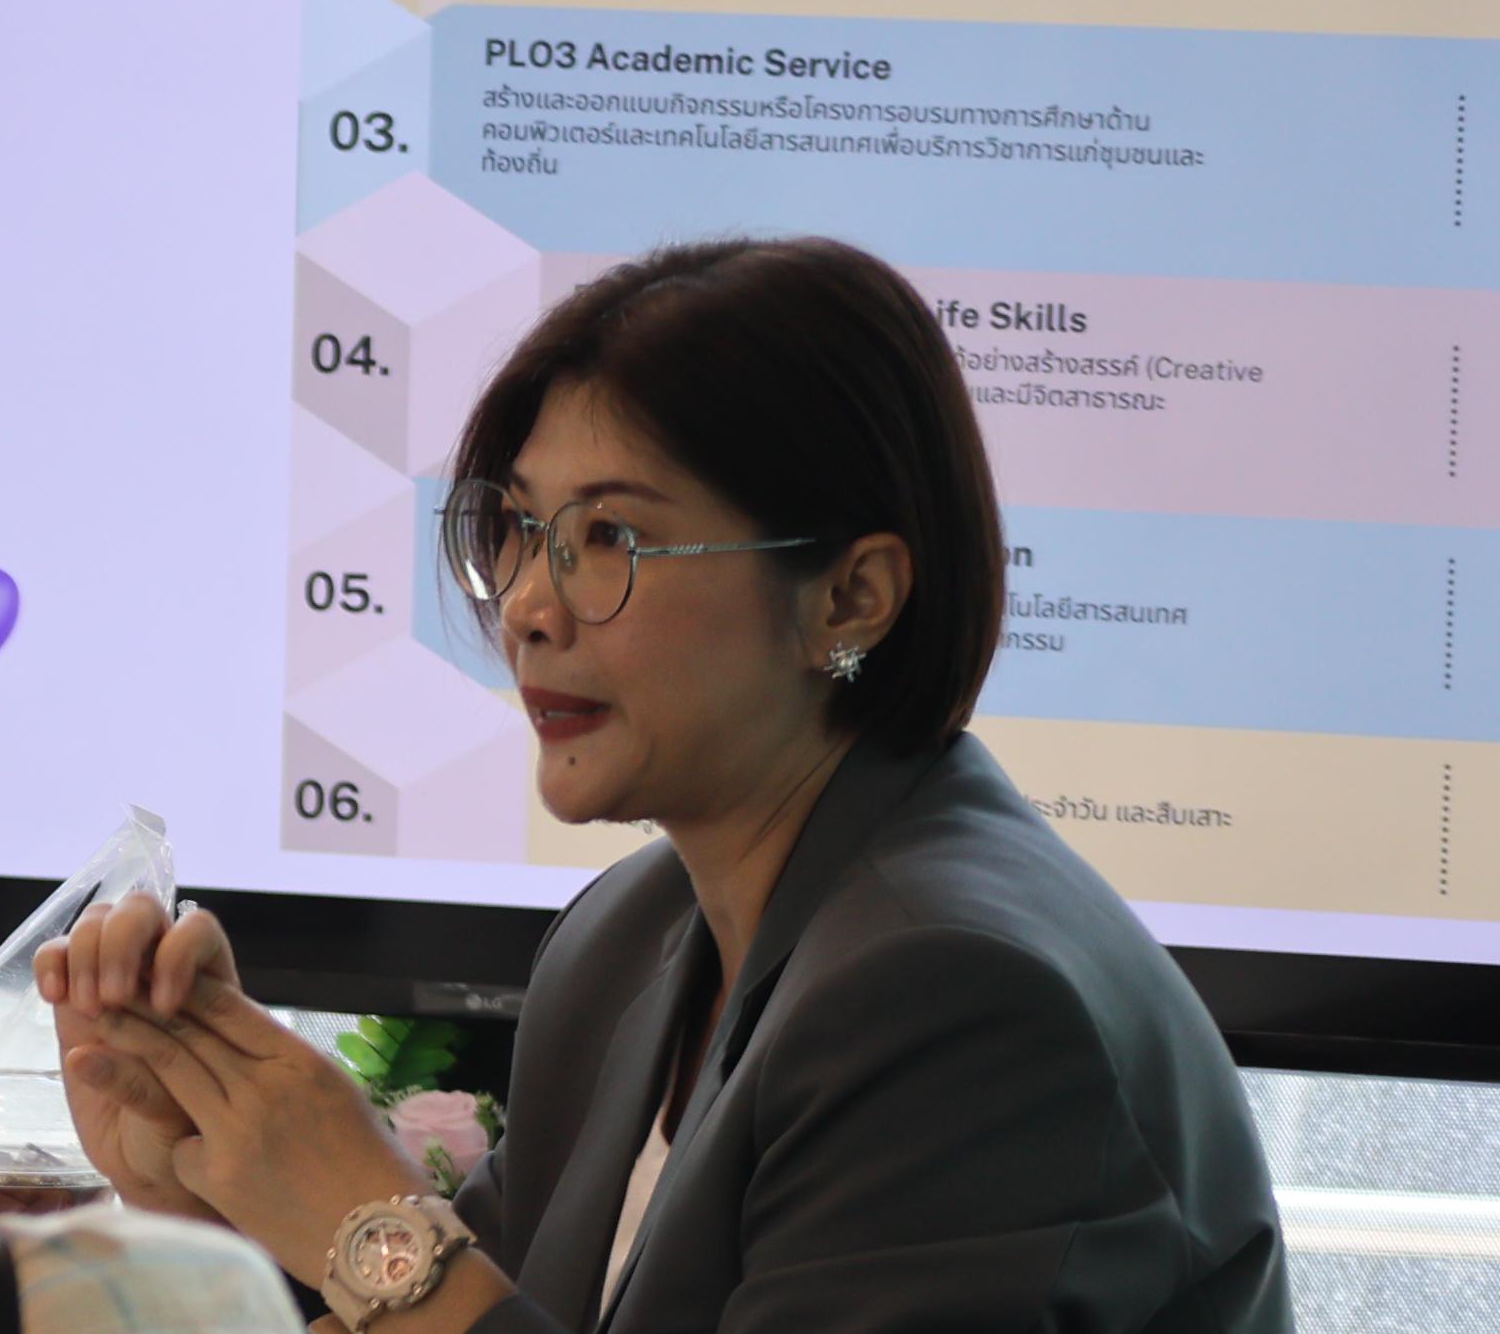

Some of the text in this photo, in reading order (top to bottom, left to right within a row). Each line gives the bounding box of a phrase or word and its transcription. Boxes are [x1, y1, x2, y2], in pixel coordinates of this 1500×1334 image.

[486, 39, 891, 80] PLO3 Academic Service
[330, 111, 408, 153] 03.
[481, 146, 558, 175] ท้องถิ่น
[936, 299, 1087, 333] ife Skills
[312, 333, 389, 376] 04.
[1146, 356, 1263, 383] (Creative
[969, 383, 1166, 411] และมีจิตสาธารณะ
[305, 571, 383, 614] 05.
[1007, 591, 1188, 625] โนโลยีสารสนเทศ
[295, 779, 372, 822] 06.
[1024, 793, 1234, 827] ระจำวัน และสืบเสาะ
